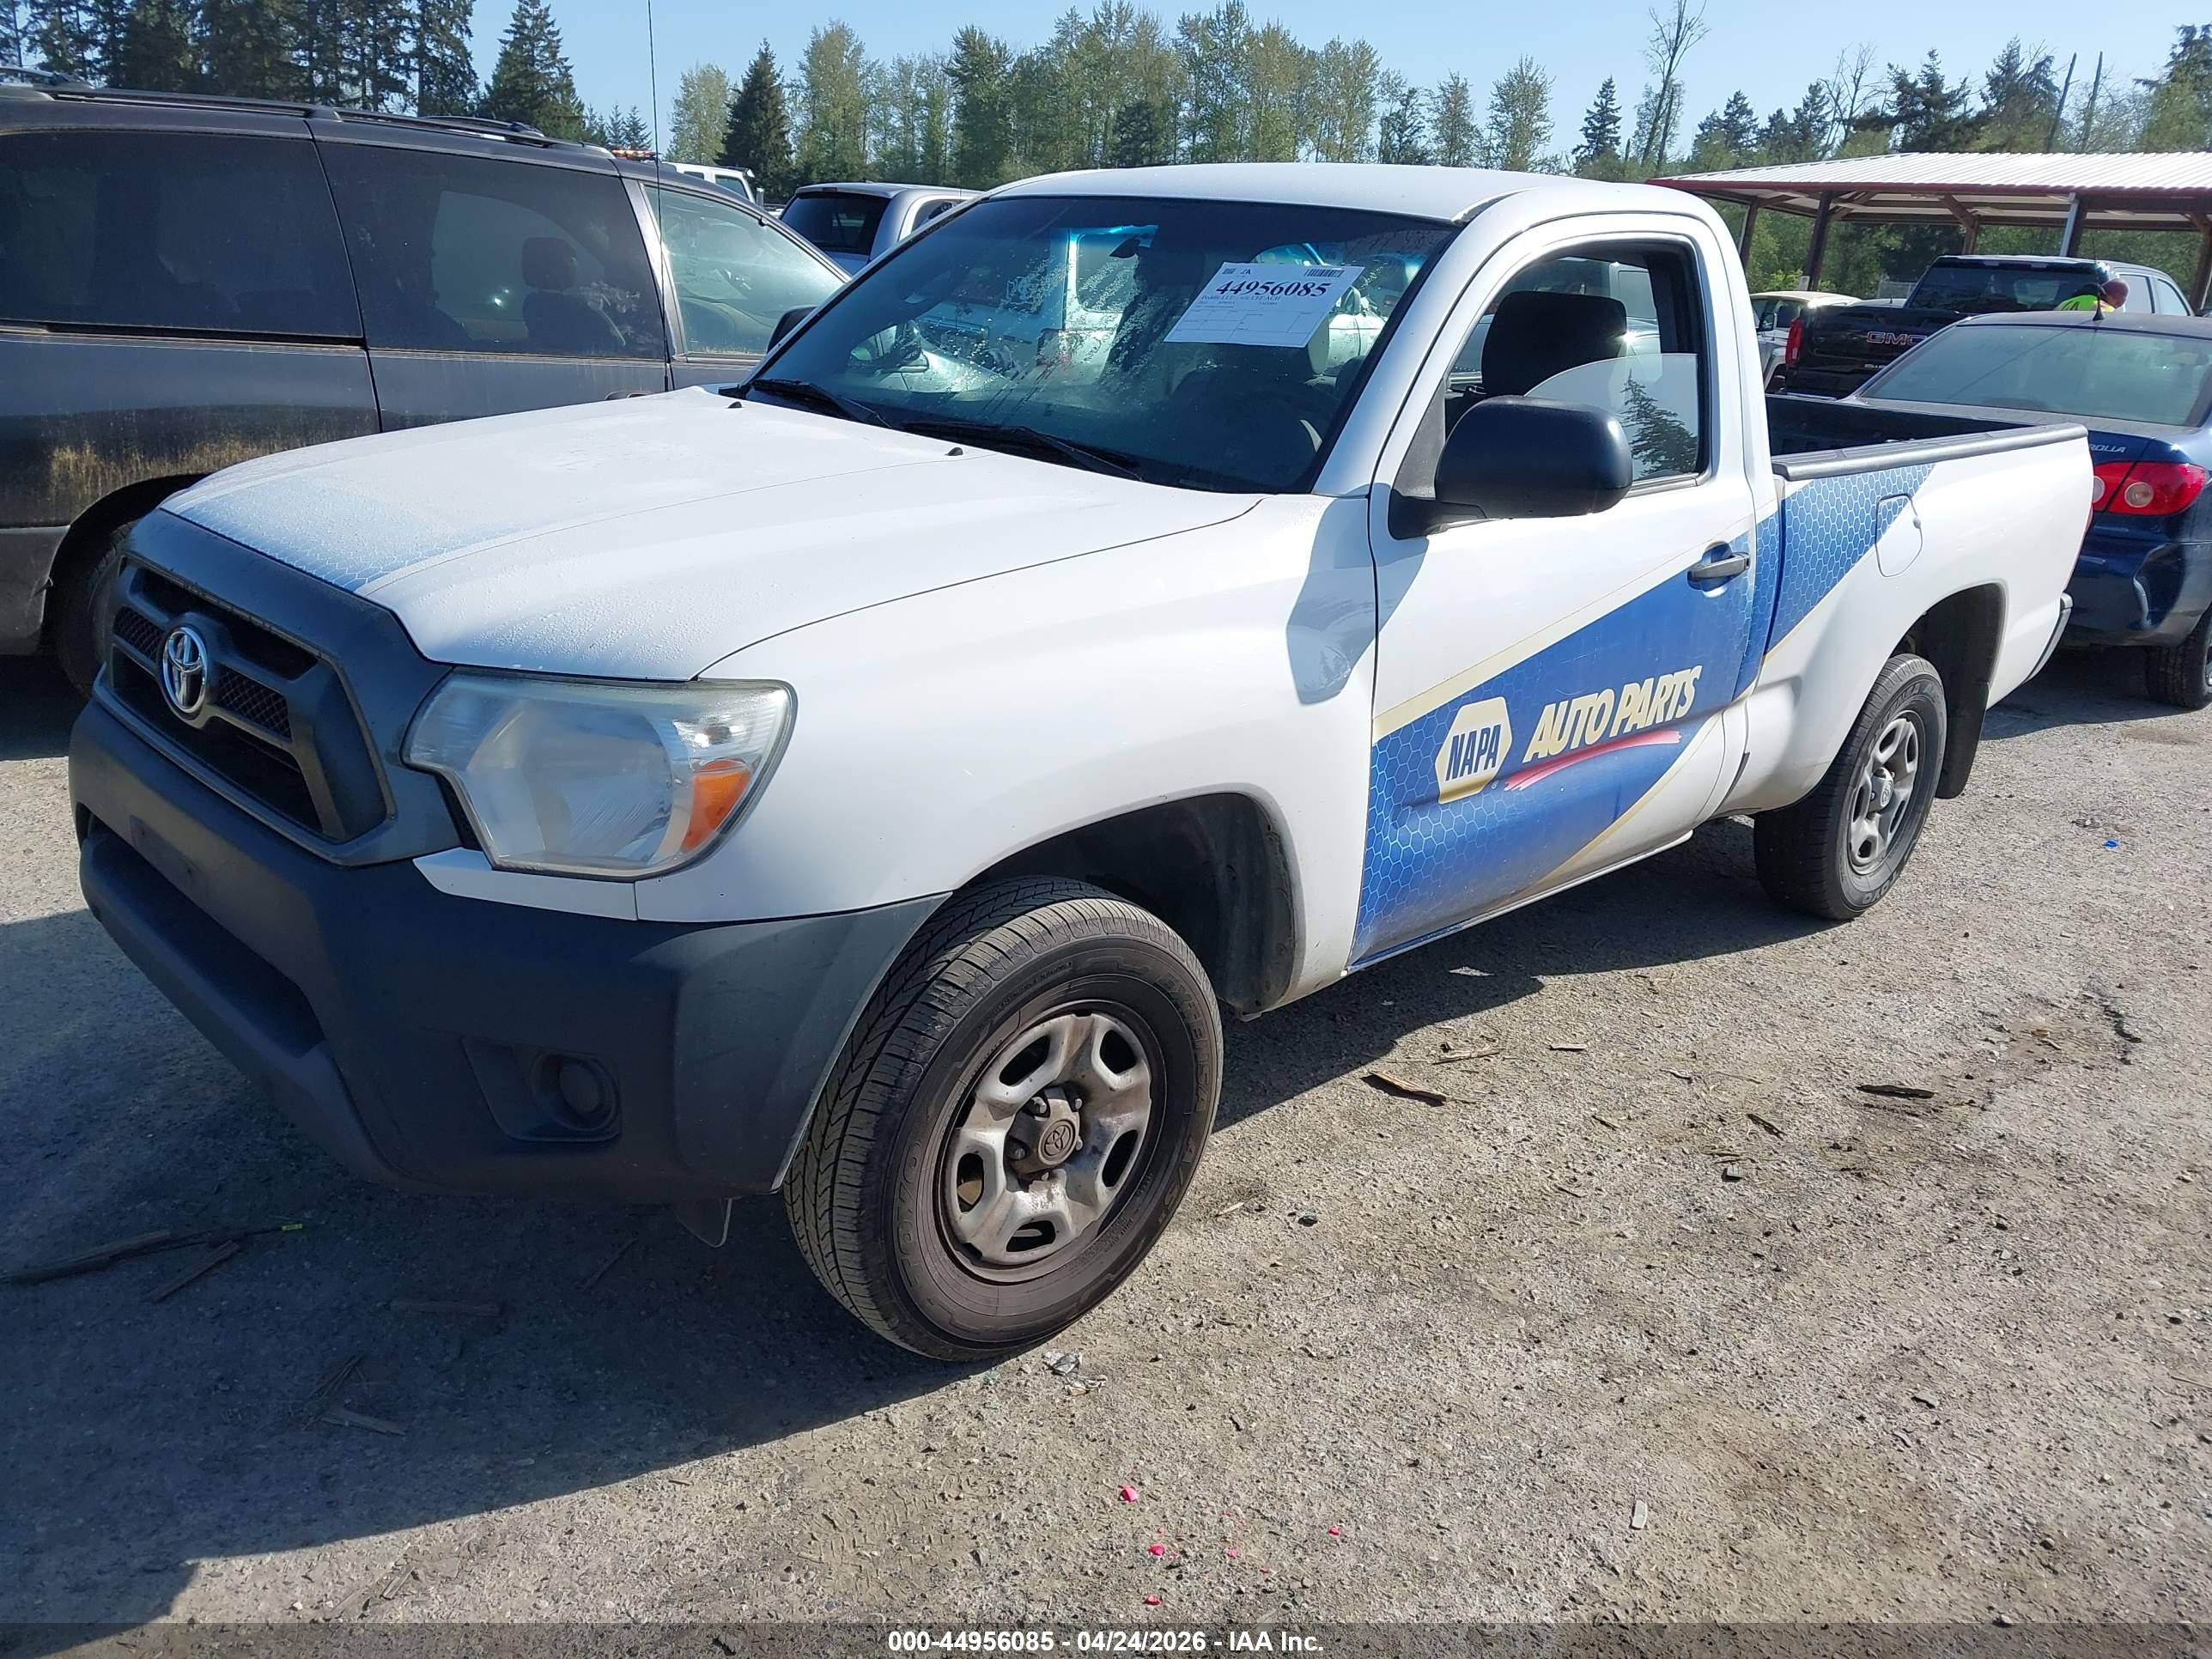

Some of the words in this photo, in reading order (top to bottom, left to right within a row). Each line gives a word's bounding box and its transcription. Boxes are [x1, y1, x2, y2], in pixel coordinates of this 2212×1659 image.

[1216, 281, 1333, 297] 44956085
[1866, 331, 1927, 345] GMC
[2089, 444, 2126, 453] ROLLA
[1522, 689, 1615, 763] AUTO
[1608, 665, 1703, 738] PARTS
[1445, 725, 1502, 781] NAPA
[897, 1140, 924, 1288] TOYO
